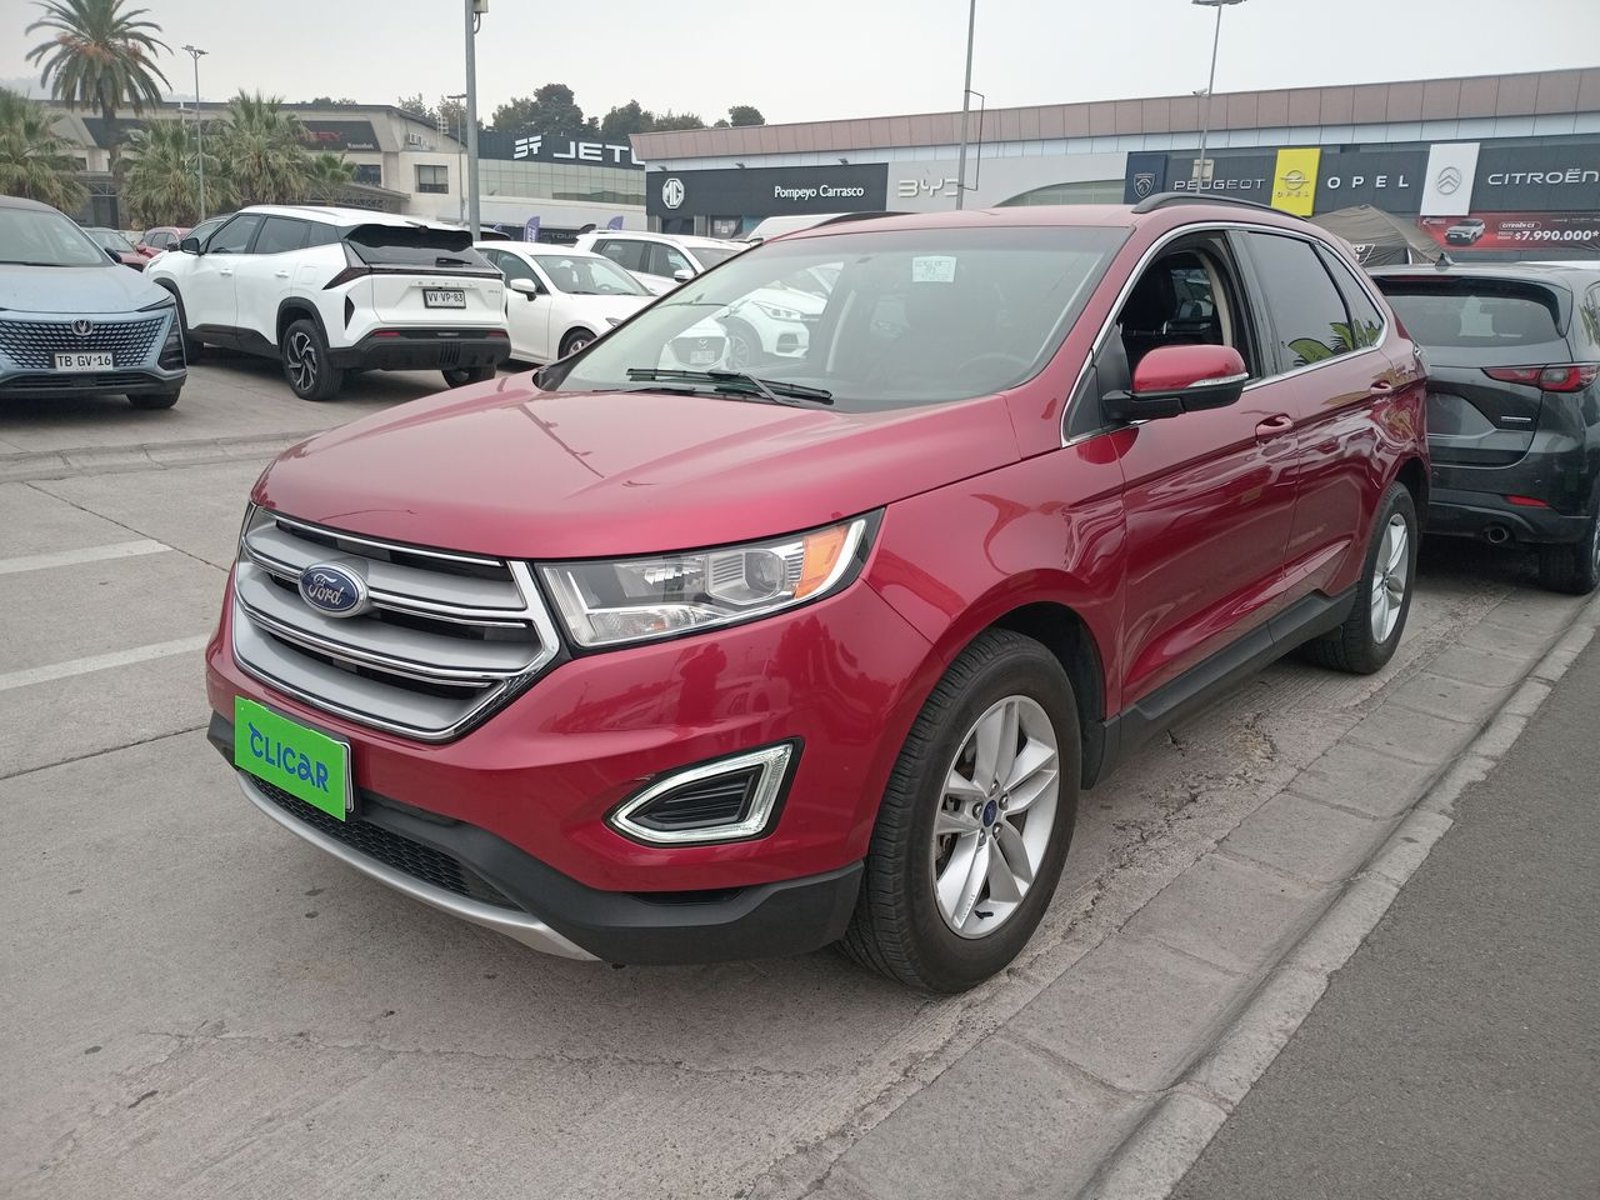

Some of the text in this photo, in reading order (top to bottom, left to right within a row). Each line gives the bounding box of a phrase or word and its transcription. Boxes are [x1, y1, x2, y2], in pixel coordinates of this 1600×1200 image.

[1173, 179, 1266, 191] PEUGEOT
[1327, 175, 1410, 190] OPEL
[662, 178, 685, 209] MG
[774, 184, 865, 201] Pompeyo Carrasco
[308, 572, 345, 606] Ford
